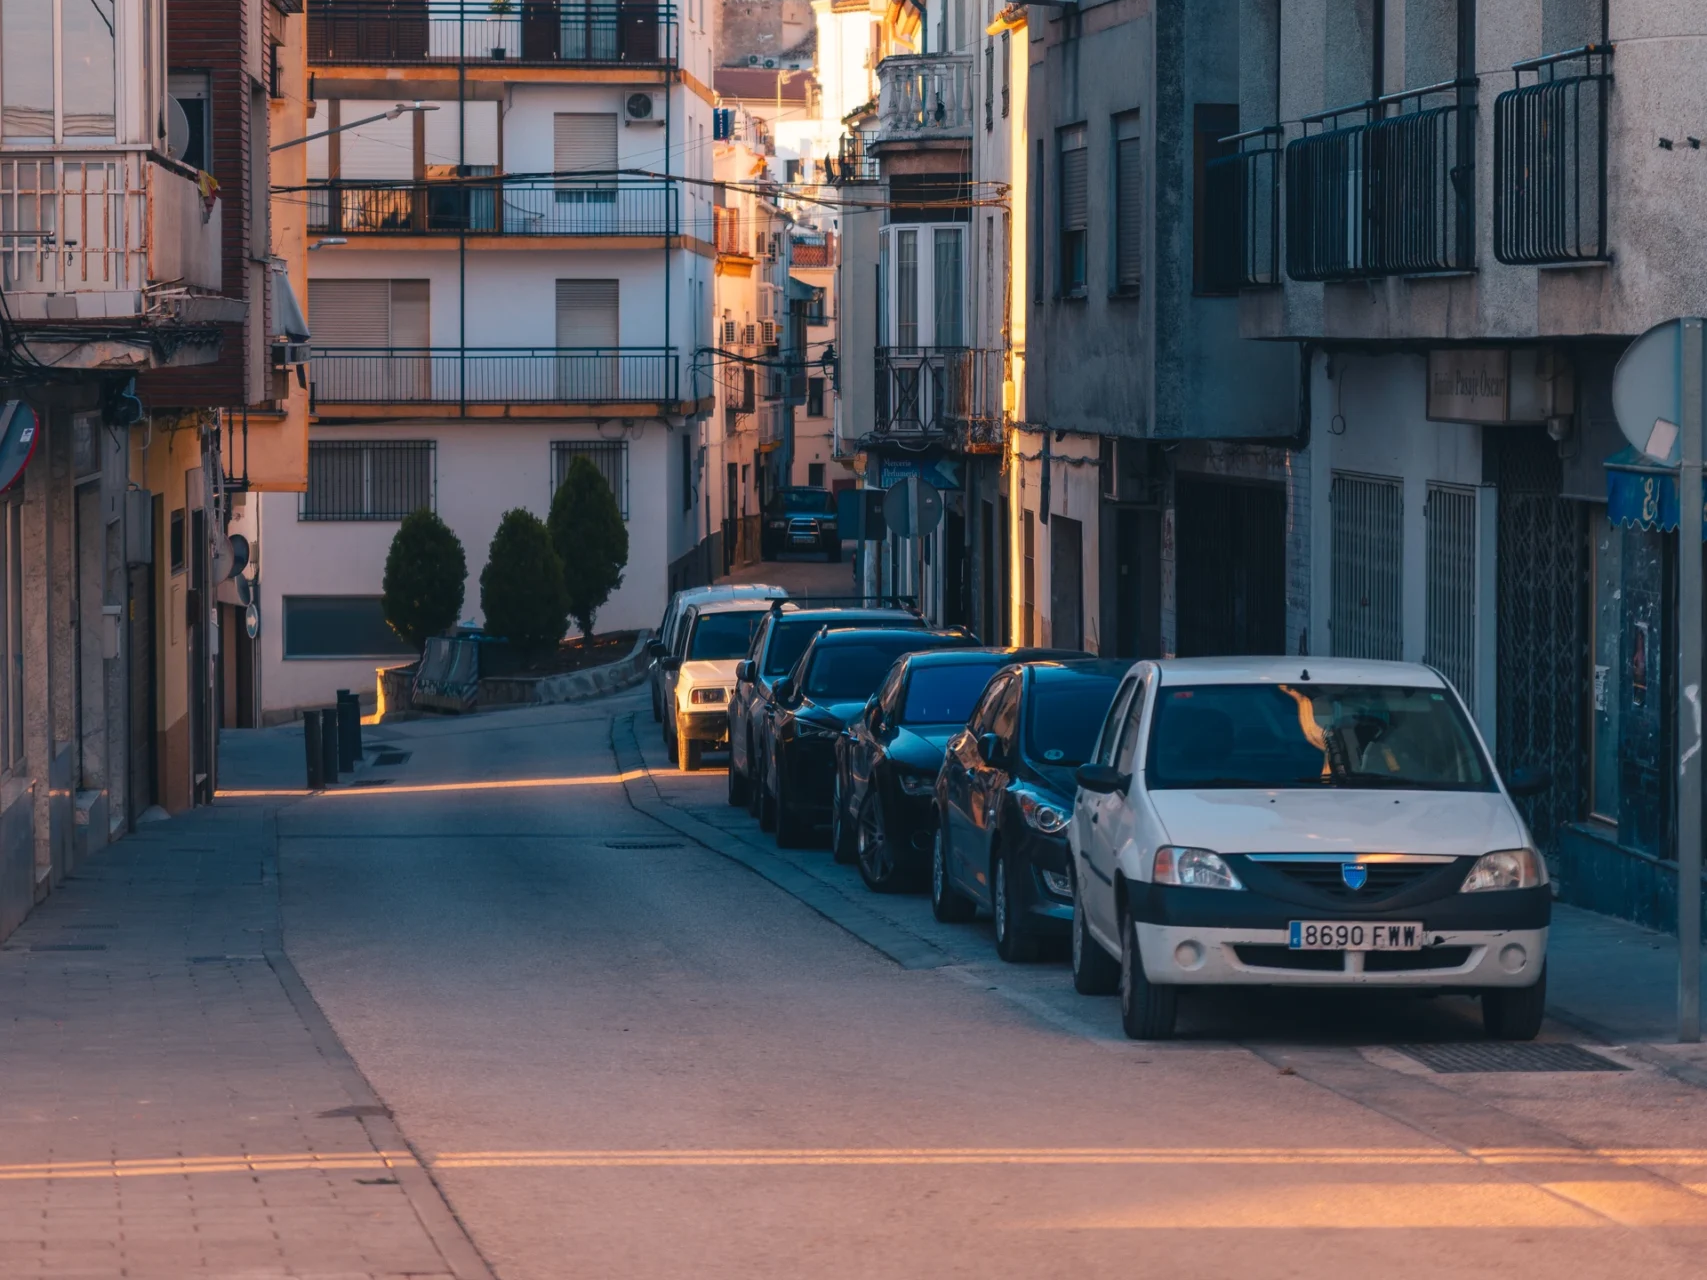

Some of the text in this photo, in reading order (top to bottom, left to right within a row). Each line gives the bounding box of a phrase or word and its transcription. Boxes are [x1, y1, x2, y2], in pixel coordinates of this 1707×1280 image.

[1455, 367, 1478, 403] Pasaje
[1480, 363, 1505, 397] Óscar
[1305, 925, 1364, 946] 8690
[1373, 925, 1416, 947] FWW
